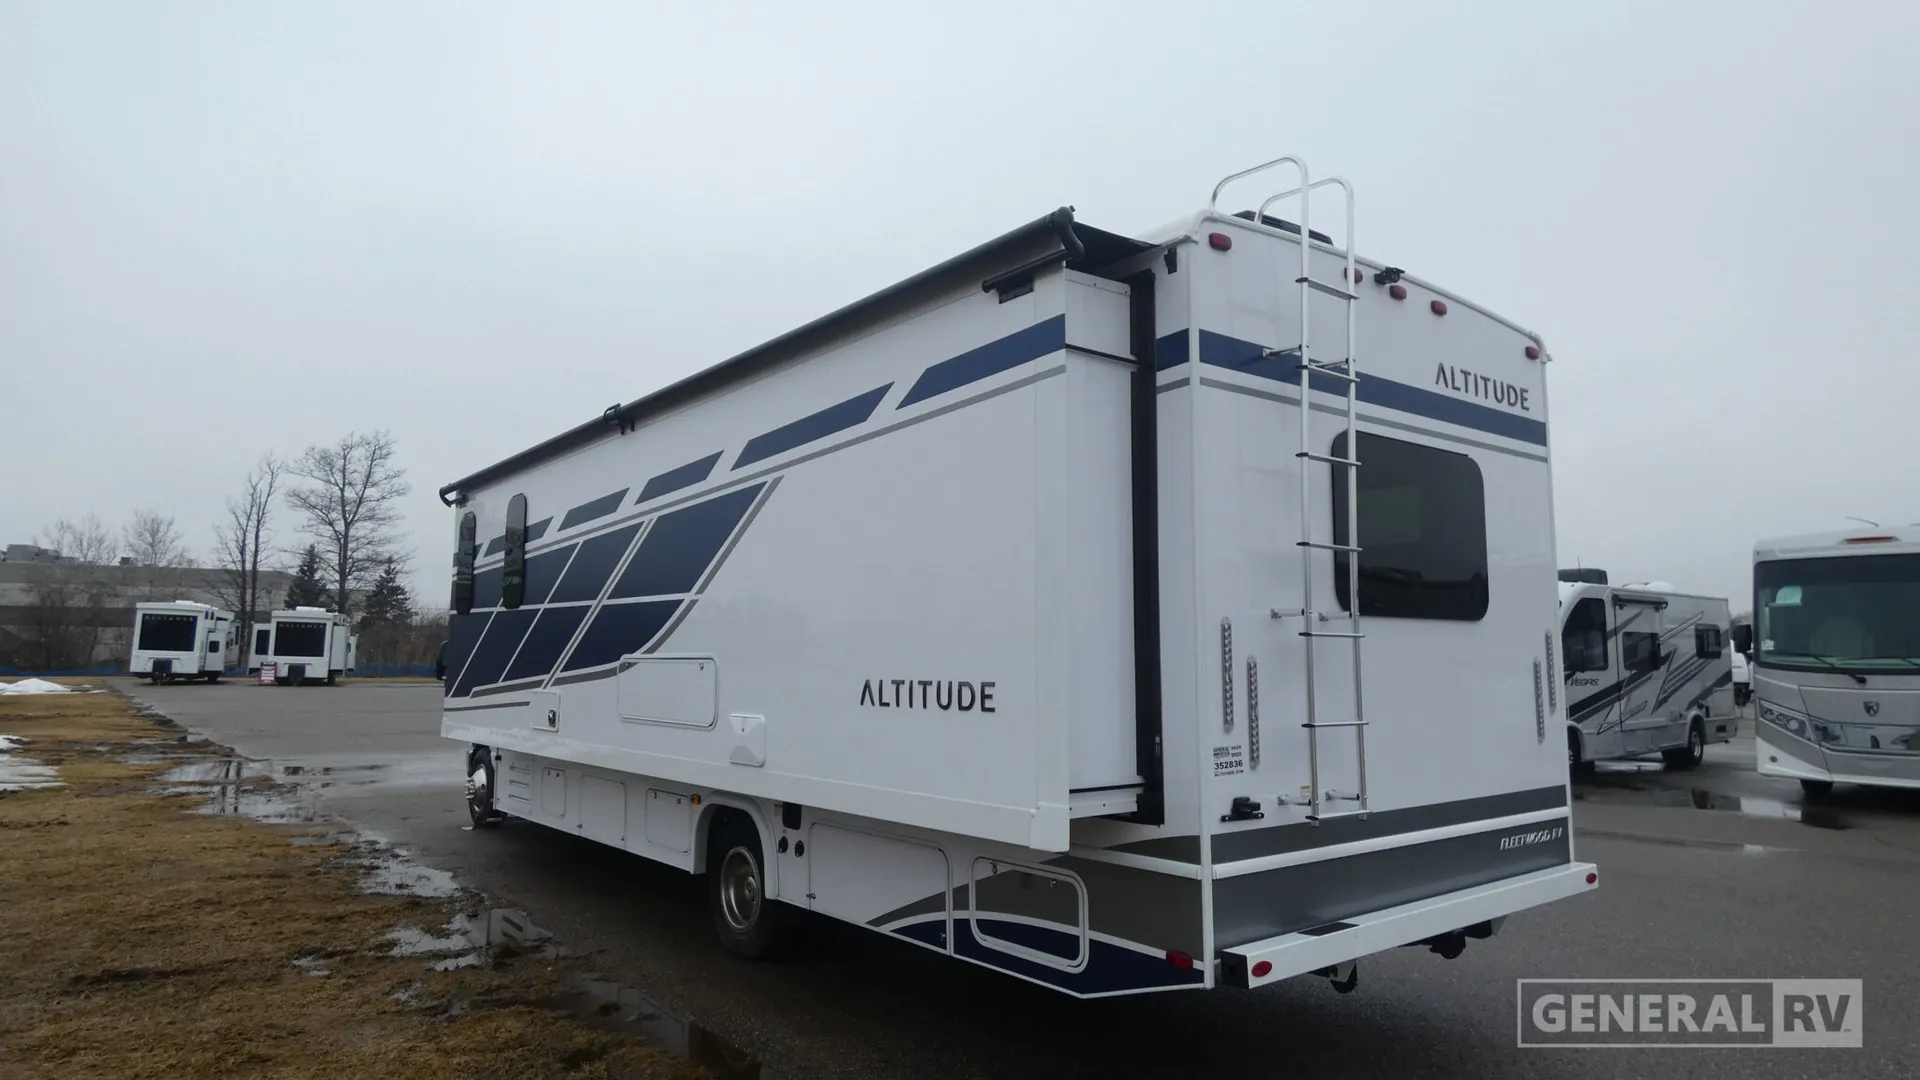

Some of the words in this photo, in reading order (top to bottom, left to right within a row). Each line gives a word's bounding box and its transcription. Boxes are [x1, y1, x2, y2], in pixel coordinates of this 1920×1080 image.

[1435, 362, 1530, 411] ALTITUDE
[860, 679, 996, 713] ALTITUDE
[1214, 759, 1244, 770] 352836
[1500, 830, 1550, 851] FLEETWOOD
